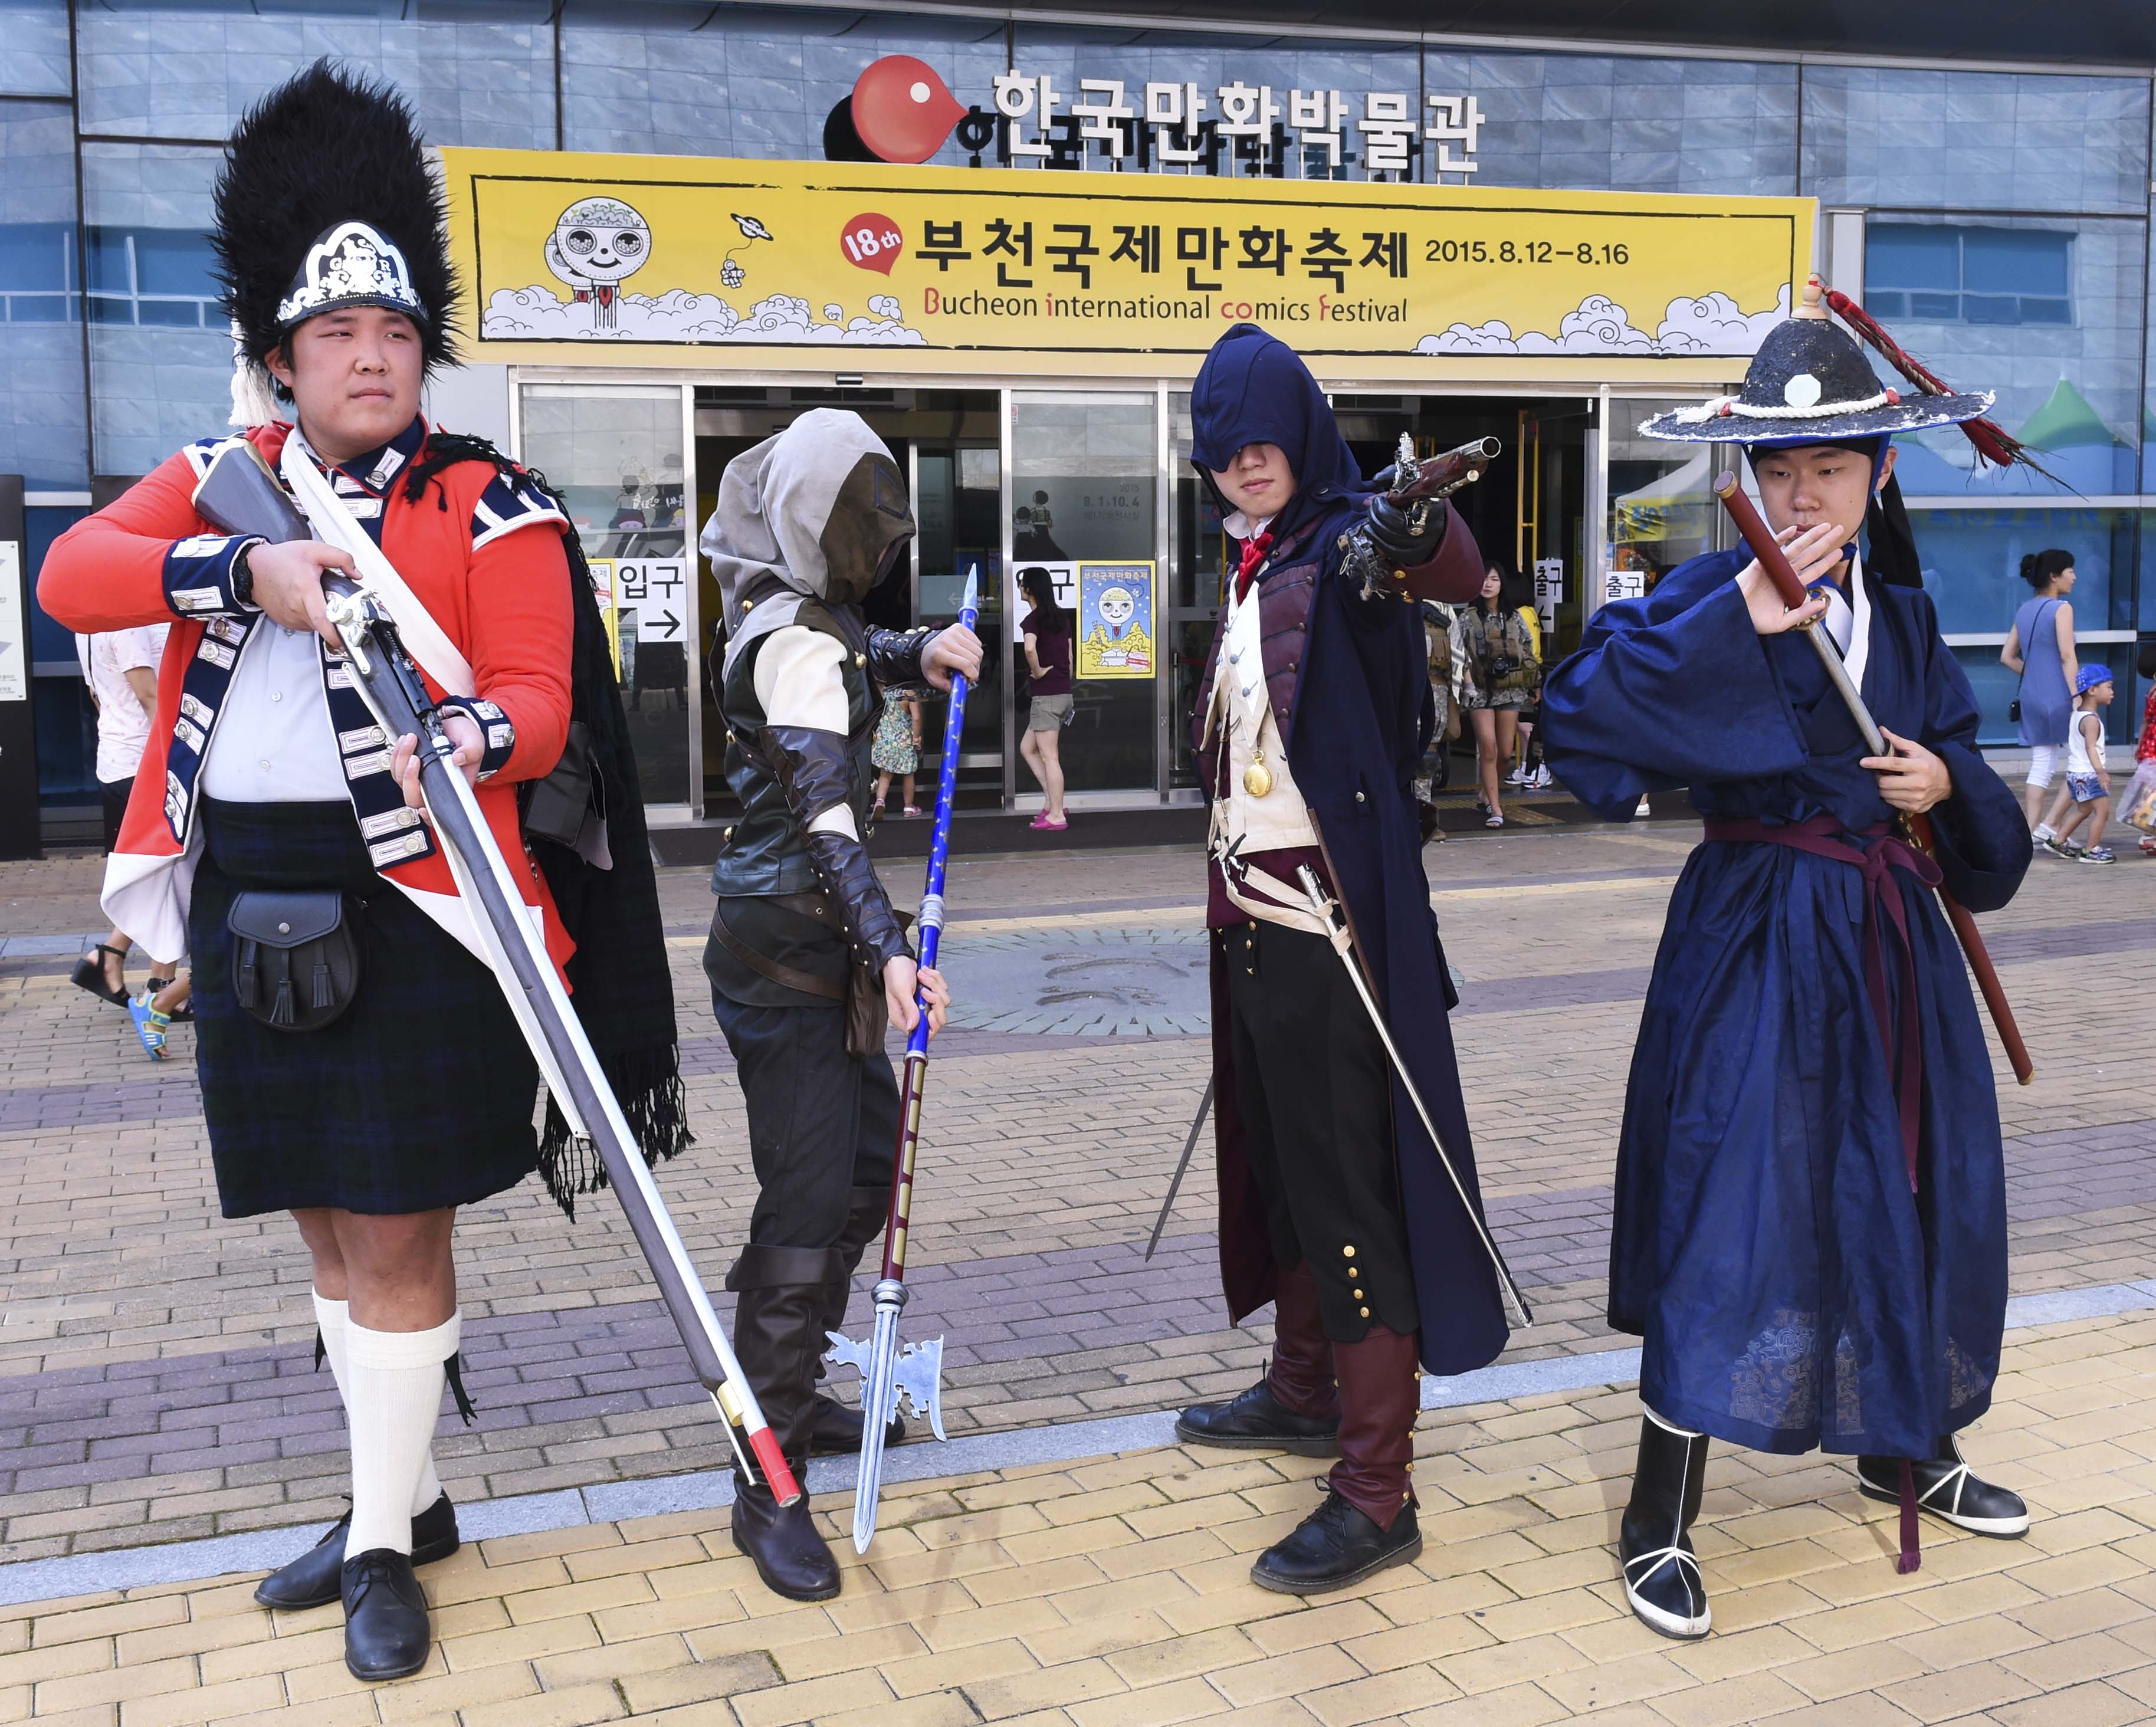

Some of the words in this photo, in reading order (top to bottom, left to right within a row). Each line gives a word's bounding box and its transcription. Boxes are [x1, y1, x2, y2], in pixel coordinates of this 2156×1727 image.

[994, 70, 1485, 172] 한국만화박물관
[845, 228, 901, 261] 18th
[915, 218, 1408, 293] 부천국제만화축제
[1425, 239, 1629, 265] 2015.8.12-8.16
[378, 259, 391, 272] R
[924, 287, 1037, 316] Bucheon
[1045, 293, 1210, 319] international
[1220, 296, 1310, 321] comics
[619, 564, 684, 599] 입구
[1535, 566, 1562, 596] 출구
[1606, 576, 1642, 597] 출구
